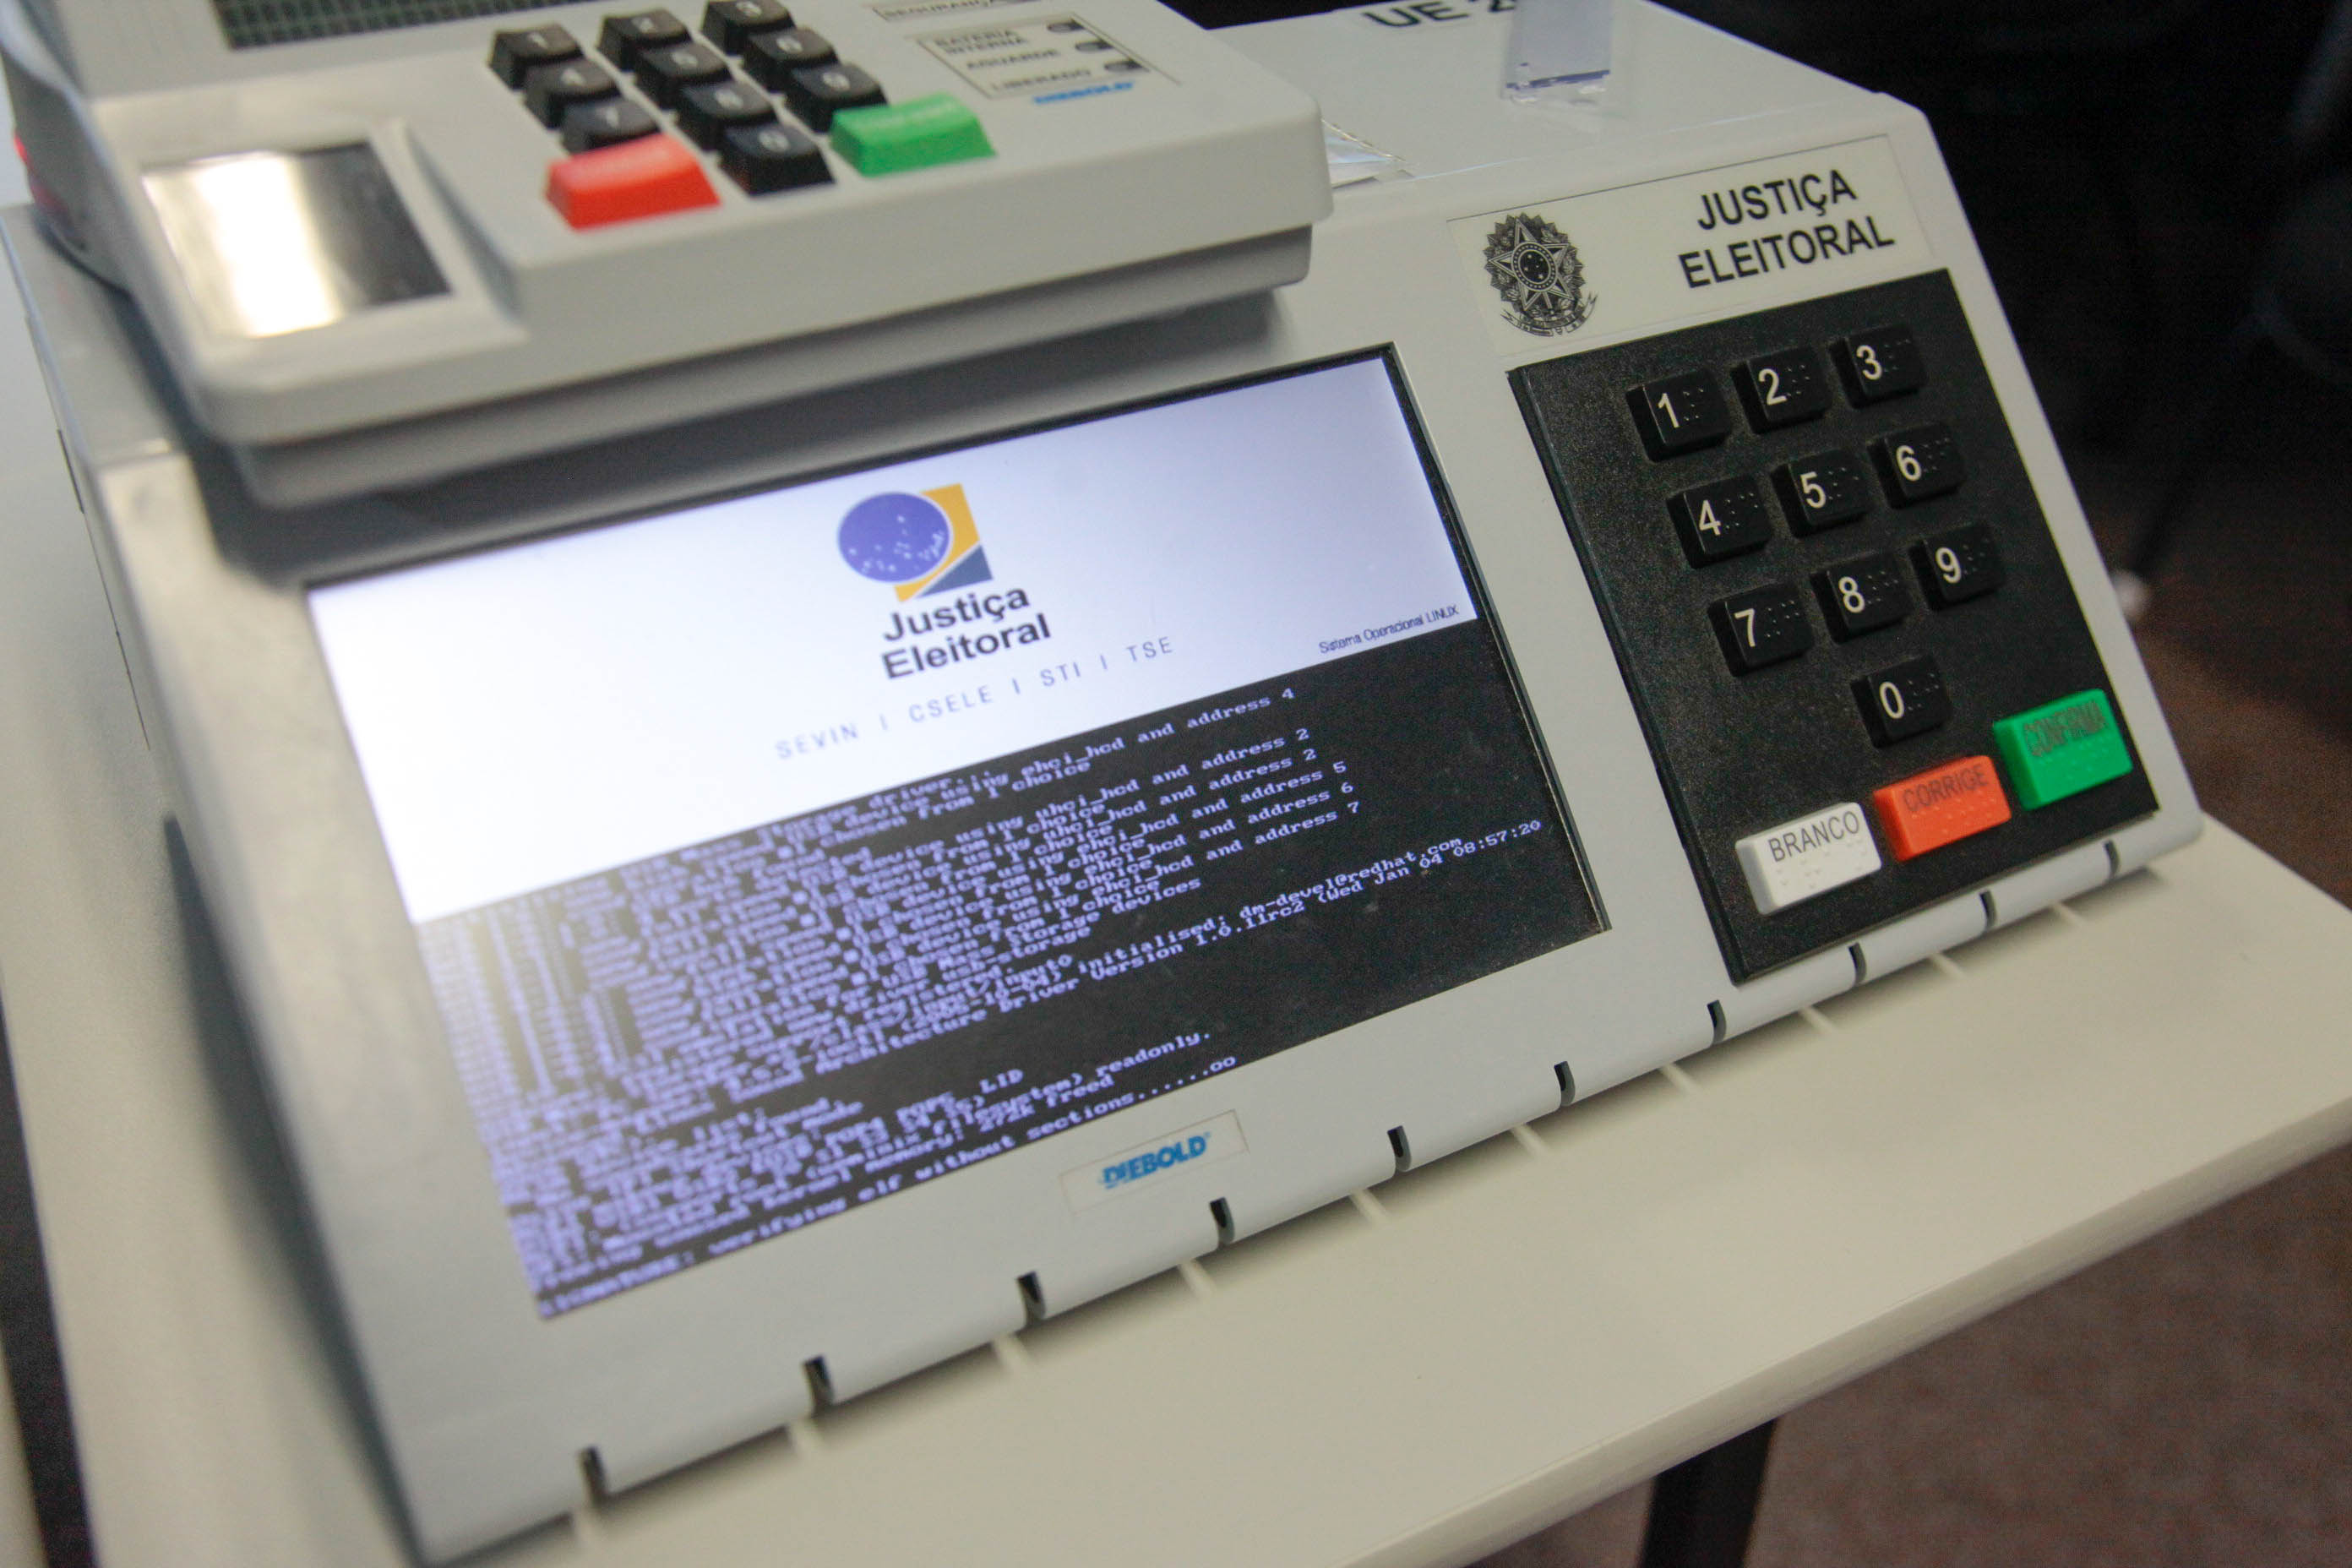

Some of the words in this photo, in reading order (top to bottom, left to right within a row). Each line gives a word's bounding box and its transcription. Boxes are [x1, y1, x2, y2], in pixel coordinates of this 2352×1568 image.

[1696, 169, 1857, 230] JUSTIÇA
[1677, 215, 1896, 289] ELEITORAL
[1757, 368, 1788, 406] 2
[1855, 343, 1883, 380] 3
[1657, 392, 1680, 428] 1
[1894, 444, 1923, 482] 6
[1799, 471, 1827, 509] 5
[1697, 498, 1723, 538] 4
[1935, 546, 1963, 584] 9
[883, 587, 1031, 641] Justiça
[1837, 575, 1866, 614] 8
[880, 612, 1052, 679] Eleitoral
[1319, 634, 1363, 654] Sistema
[1425, 604, 1460, 623] LINUX
[1733, 609, 1758, 648] 7
[775, 721, 860, 760] SEVIN
[907, 685, 994, 723] CSELE
[1040, 662, 1082, 687] STI
[1126, 636, 1173, 663] TSE
[1136, 722, 1174, 743] and
[1186, 698, 1271, 728] address
[1281, 689, 1294, 701] 4
[1878, 680, 1906, 720] 0
[1152, 764, 1190, 784] and
[1200, 738, 1286, 770] address
[1295, 728, 1309, 741] 2
[1159, 784, 1197, 805] and
[1208, 758, 1293, 790] address
[1303, 748, 1316, 761] 2
[1190, 796, 1228, 817] and
[1239, 770, 1323, 802] address
[1333, 760, 1347, 773] 5
[1198, 817, 1236, 838] and
[1247, 790, 1331, 823] address
[1340, 780, 1353, 792] 6
[1903, 763, 1989, 813] CORRIGE
[1206, 837, 1244, 858] and
[1255, 810, 1338, 843] address
[1348, 800, 1361, 813] 7
[1768, 809, 1860, 863] BRANCO
[1092, 941, 1184, 979] Version
[1374, 865, 1410, 883] Jan
[1419, 851, 1444, 868] 04
[1452, 818, 1542, 857] 08:57:20
[1111, 877, 1201, 912] devices
[1097, 1032, 1214, 1076] readonly.
[1100, 1134, 1209, 1190] DIEBOLD
